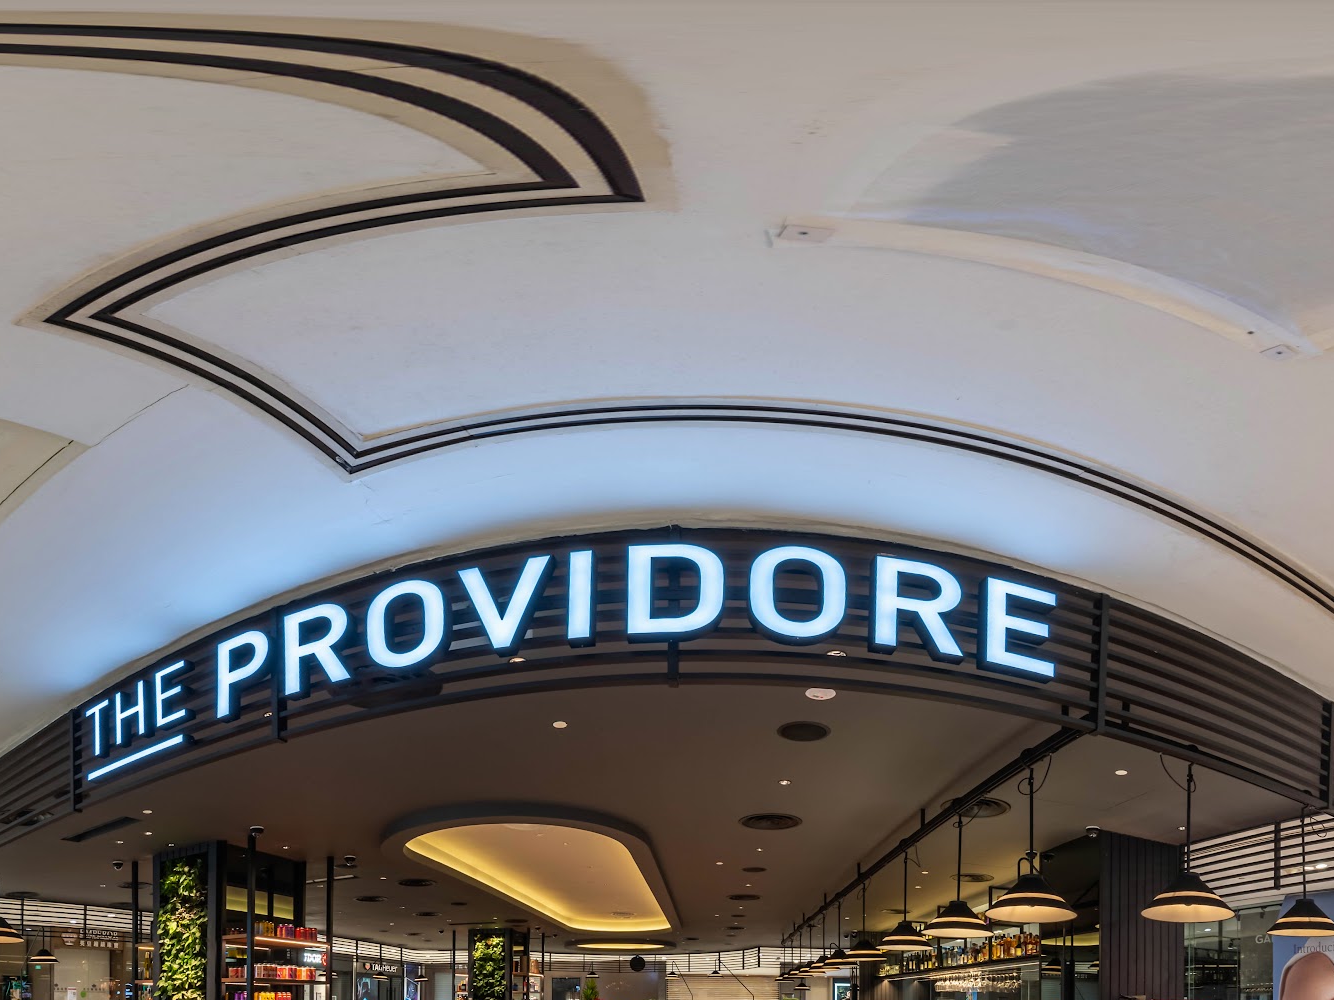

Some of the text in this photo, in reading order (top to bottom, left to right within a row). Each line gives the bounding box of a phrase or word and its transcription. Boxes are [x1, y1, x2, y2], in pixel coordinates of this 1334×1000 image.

[85, 542, 1058, 758] THE PROVIDORE
[1255, 934, 1272, 945] GA
